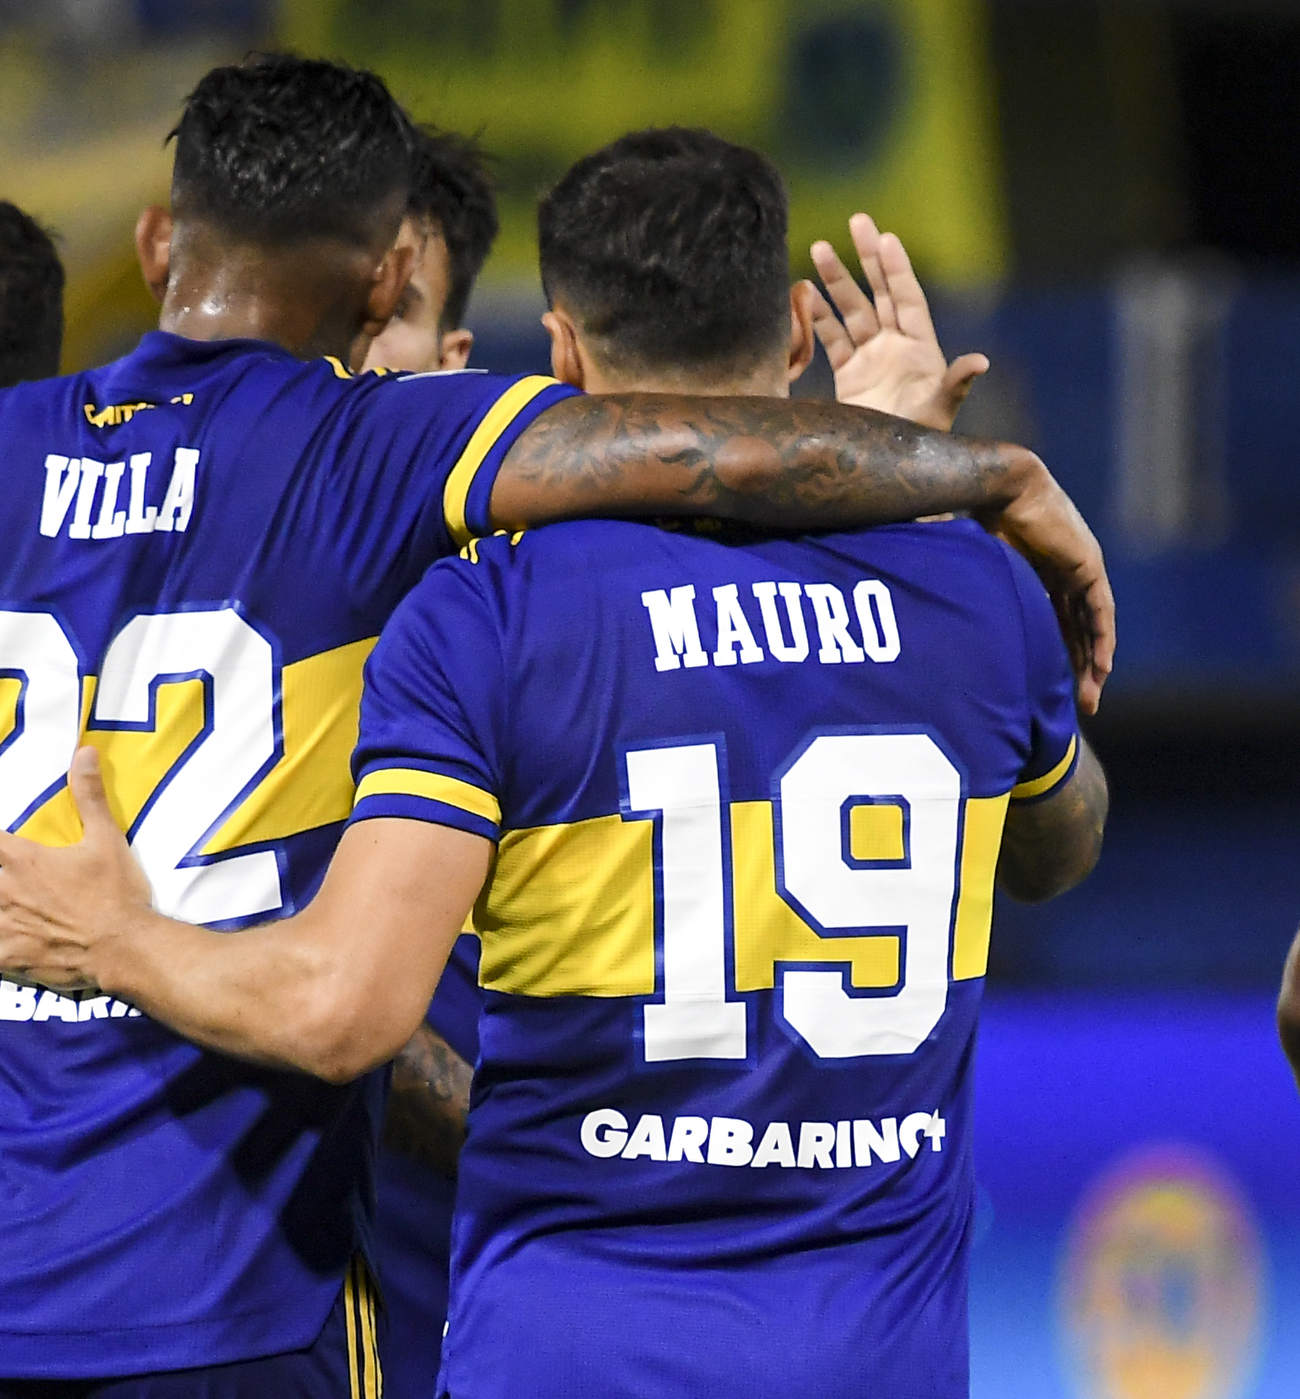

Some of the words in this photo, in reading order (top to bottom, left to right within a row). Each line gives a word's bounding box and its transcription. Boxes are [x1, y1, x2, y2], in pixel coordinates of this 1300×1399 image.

[40, 447, 200, 539] VILLA
[641, 579, 901, 672] MAURO
[625, 733, 962, 1062] 19
